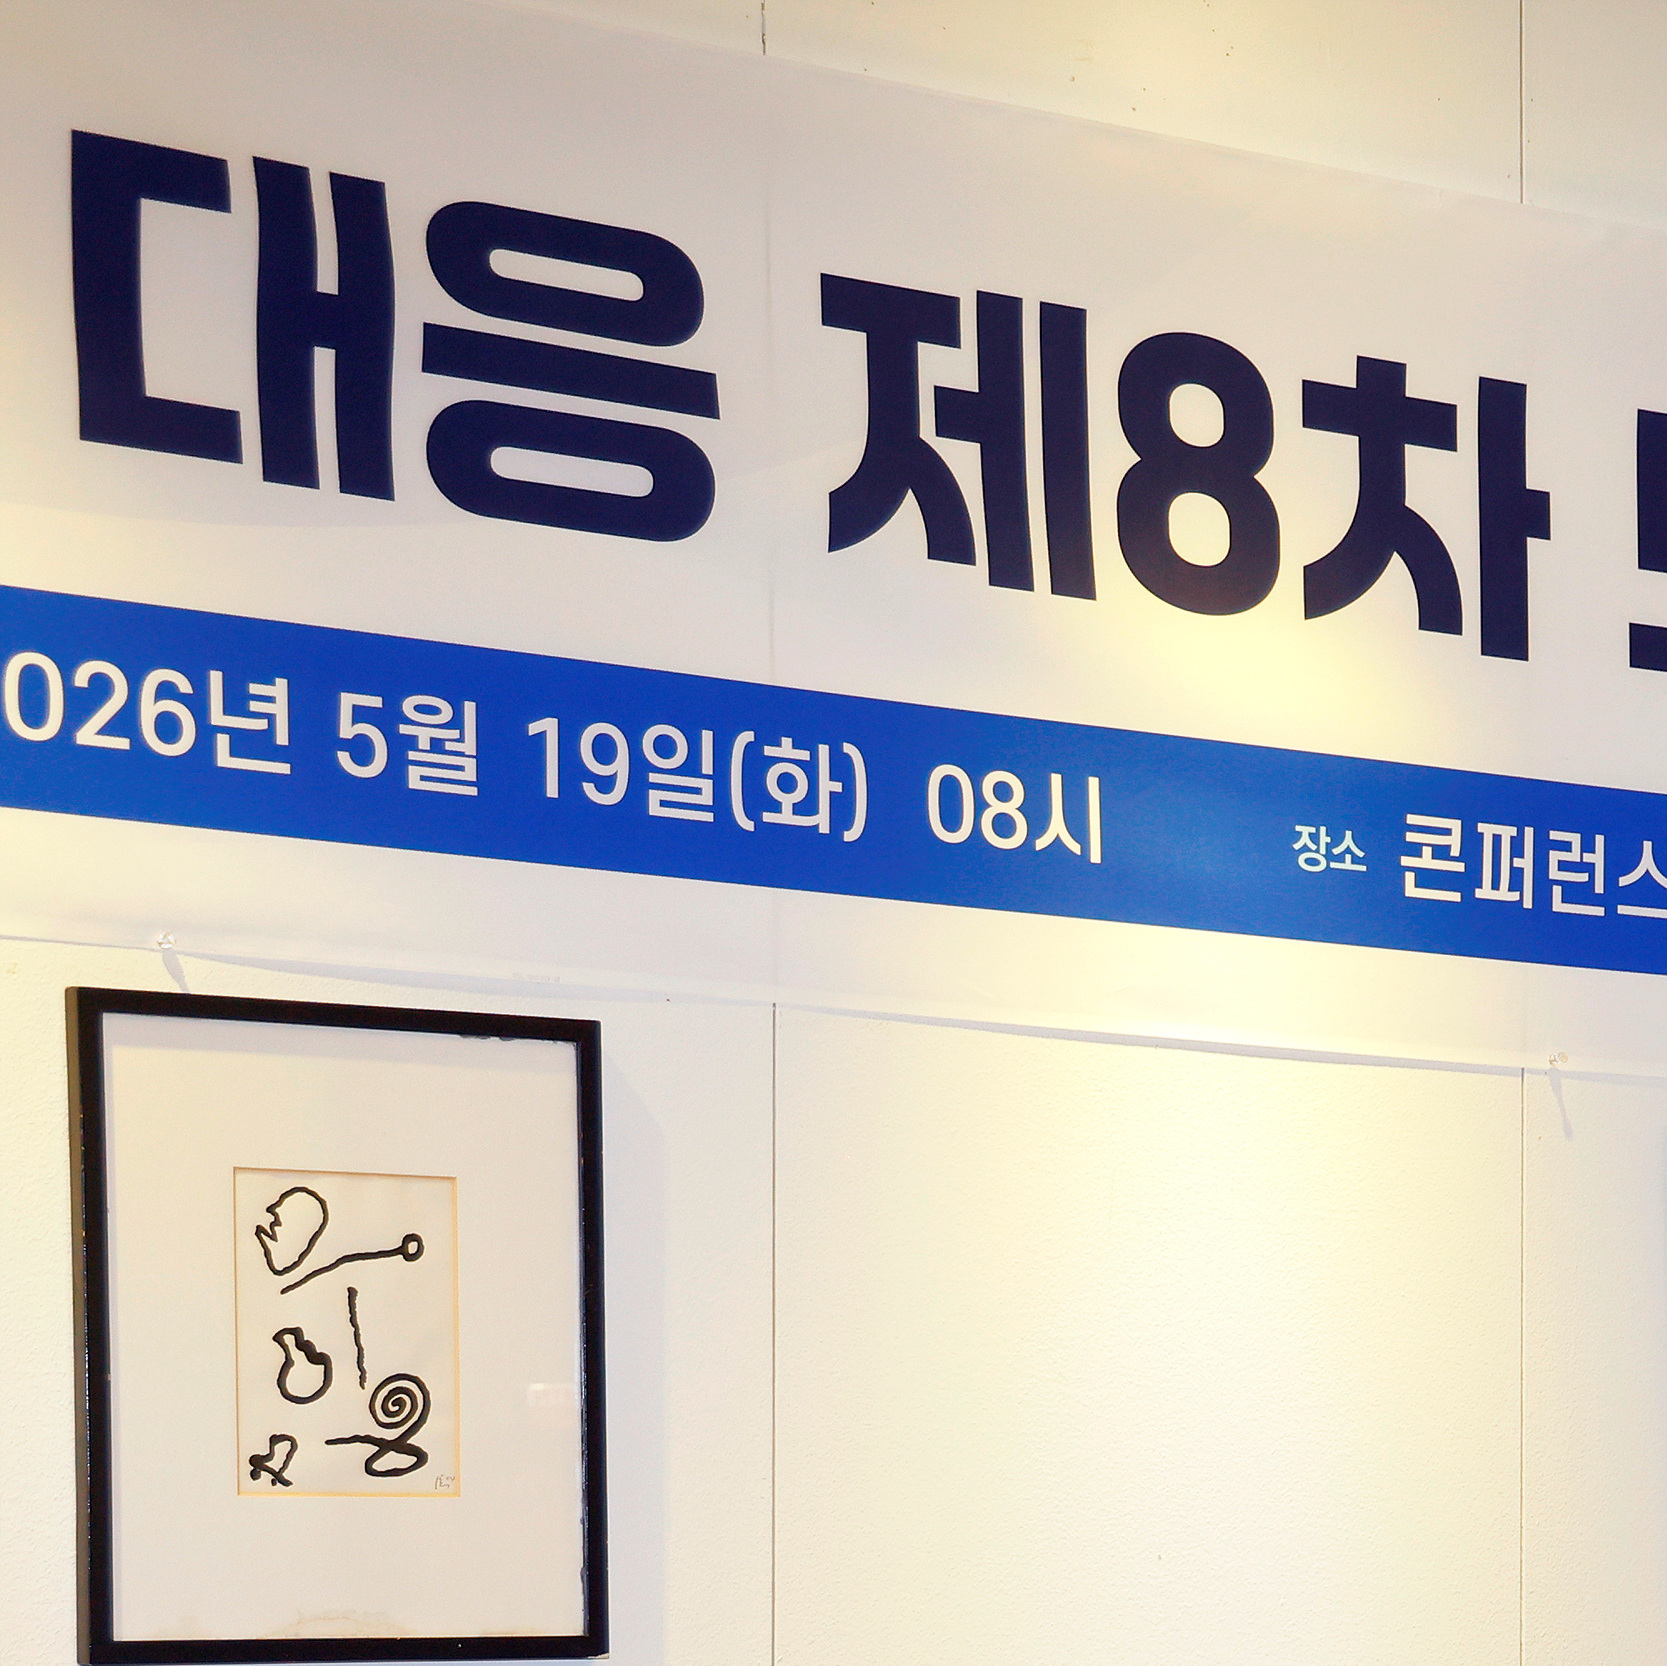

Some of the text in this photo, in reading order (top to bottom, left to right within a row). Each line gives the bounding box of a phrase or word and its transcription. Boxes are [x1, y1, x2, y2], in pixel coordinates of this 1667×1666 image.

[71, 130, 720, 541] 대응
[820, 273, 1550, 661] 제8차
[4, 652, 1102, 864] 026년 5월 19일(화) 08시
[1292, 824, 1367, 872] 장소
